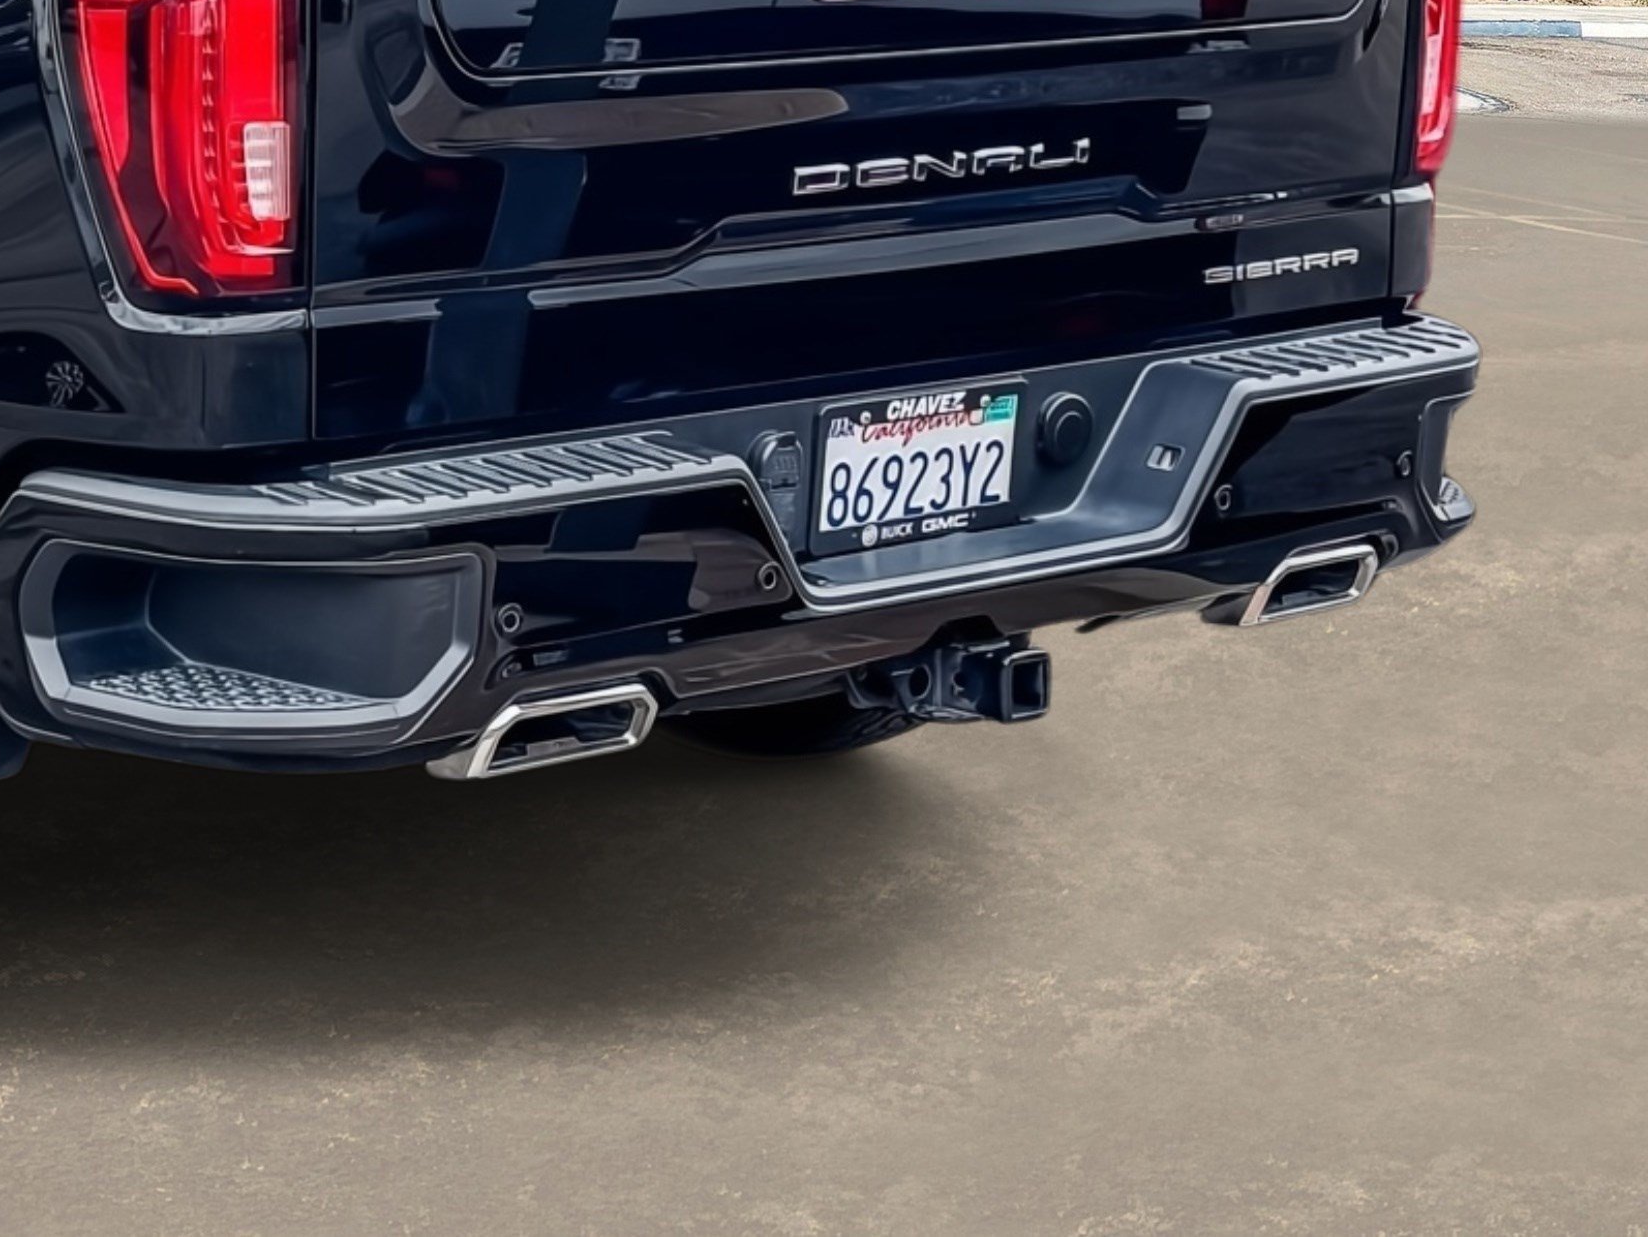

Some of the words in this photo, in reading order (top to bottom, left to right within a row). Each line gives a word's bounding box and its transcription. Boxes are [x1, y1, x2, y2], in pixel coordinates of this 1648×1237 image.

[792, 137, 1092, 196] DENALI
[1203, 248, 1360, 284] SIERRA
[886, 391, 967, 420] CHAVEZ
[826, 439, 1004, 528] 86923Y2
[880, 522, 914, 540] BUICK
[921, 512, 969, 533] GMC
